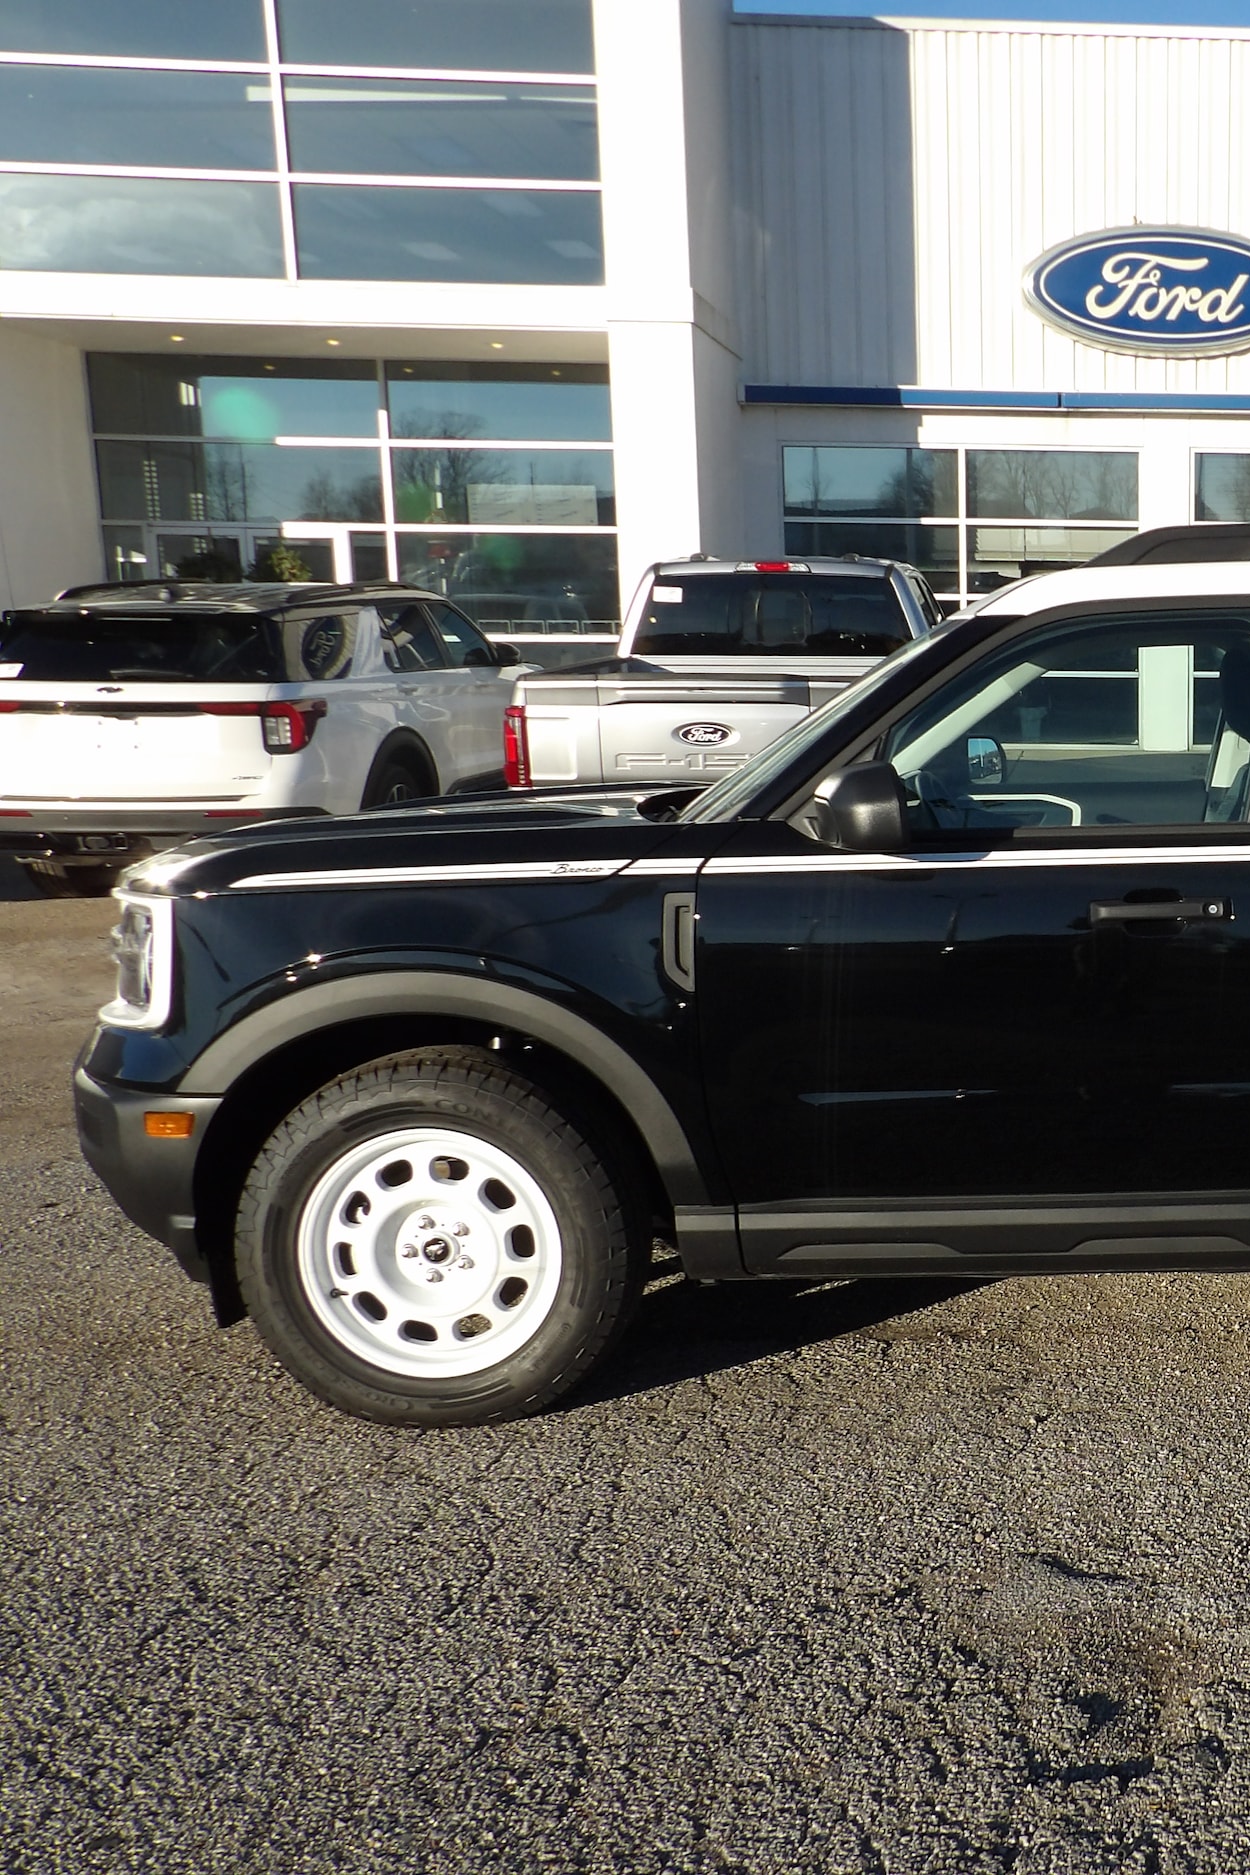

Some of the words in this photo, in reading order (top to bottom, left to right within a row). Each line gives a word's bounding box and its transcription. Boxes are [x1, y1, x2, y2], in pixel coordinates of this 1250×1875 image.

[1085, 252, 1250, 323] Ford
[687, 726, 723, 743] Ford
[615, 752, 754, 771] F-15
[549, 863, 605, 875] Bronco
